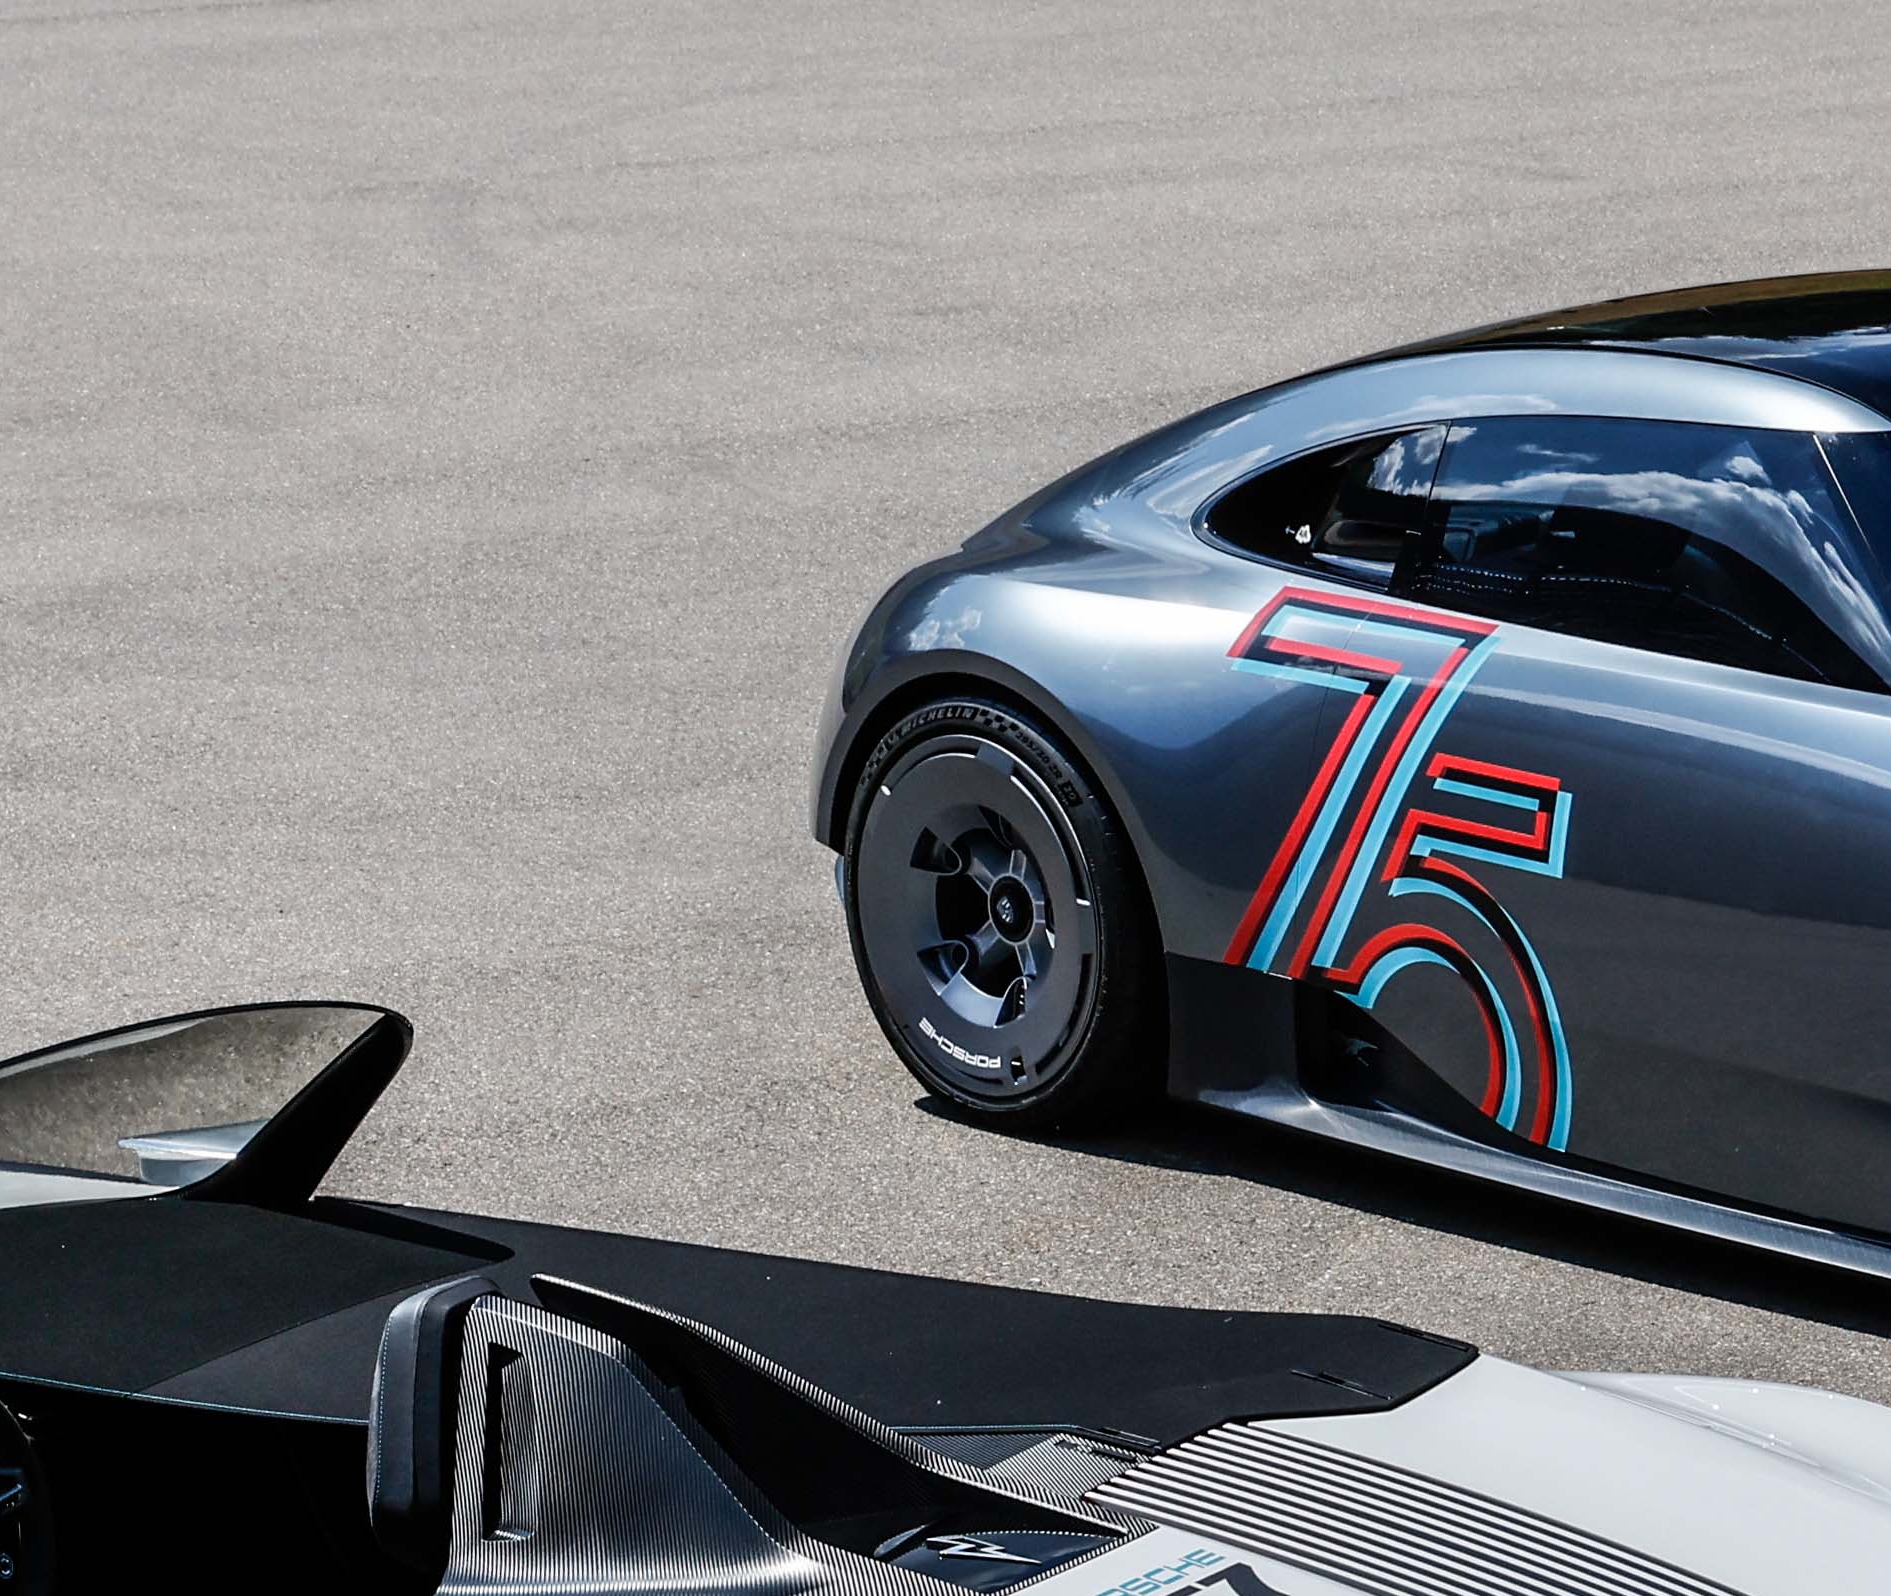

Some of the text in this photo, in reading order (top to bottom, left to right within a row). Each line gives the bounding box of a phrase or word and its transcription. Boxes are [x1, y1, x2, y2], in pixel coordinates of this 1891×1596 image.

[901, 707, 974, 735] MICHELIN
[1224, 586, 1573, 1152] 75
[918, 1017, 1002, 1069] PORSCHE
